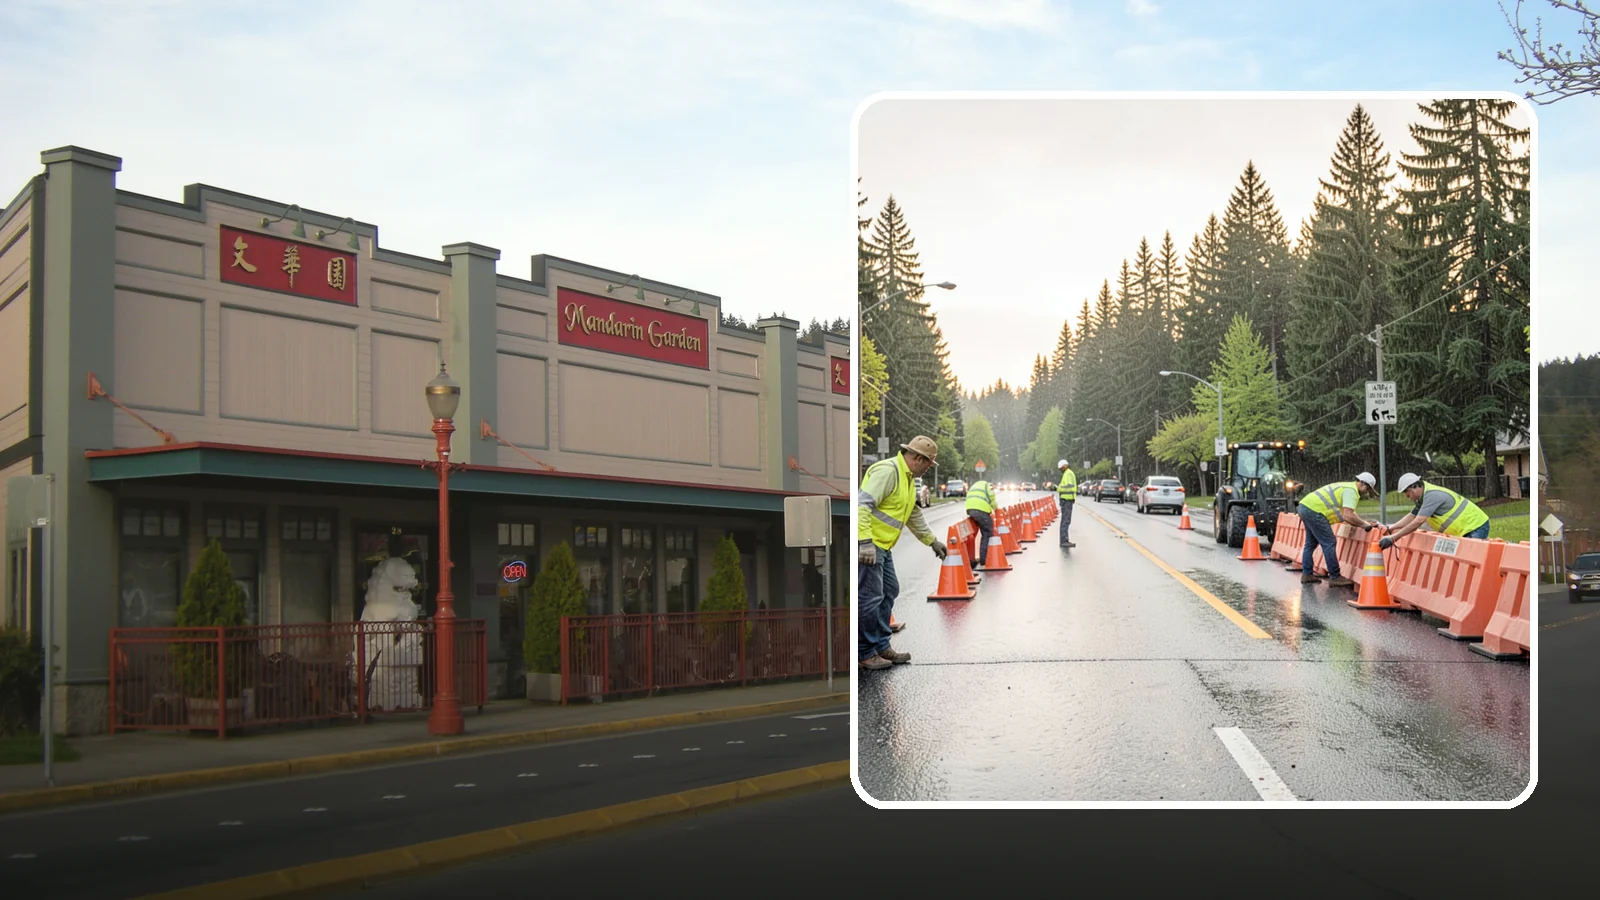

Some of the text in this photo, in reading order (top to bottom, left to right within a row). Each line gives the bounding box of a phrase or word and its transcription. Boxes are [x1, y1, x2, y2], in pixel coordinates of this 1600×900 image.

[231, 236, 346, 290] 文華園
[565, 302, 701, 351] Mandarin Garden
[503, 565, 526, 578] OPEN
